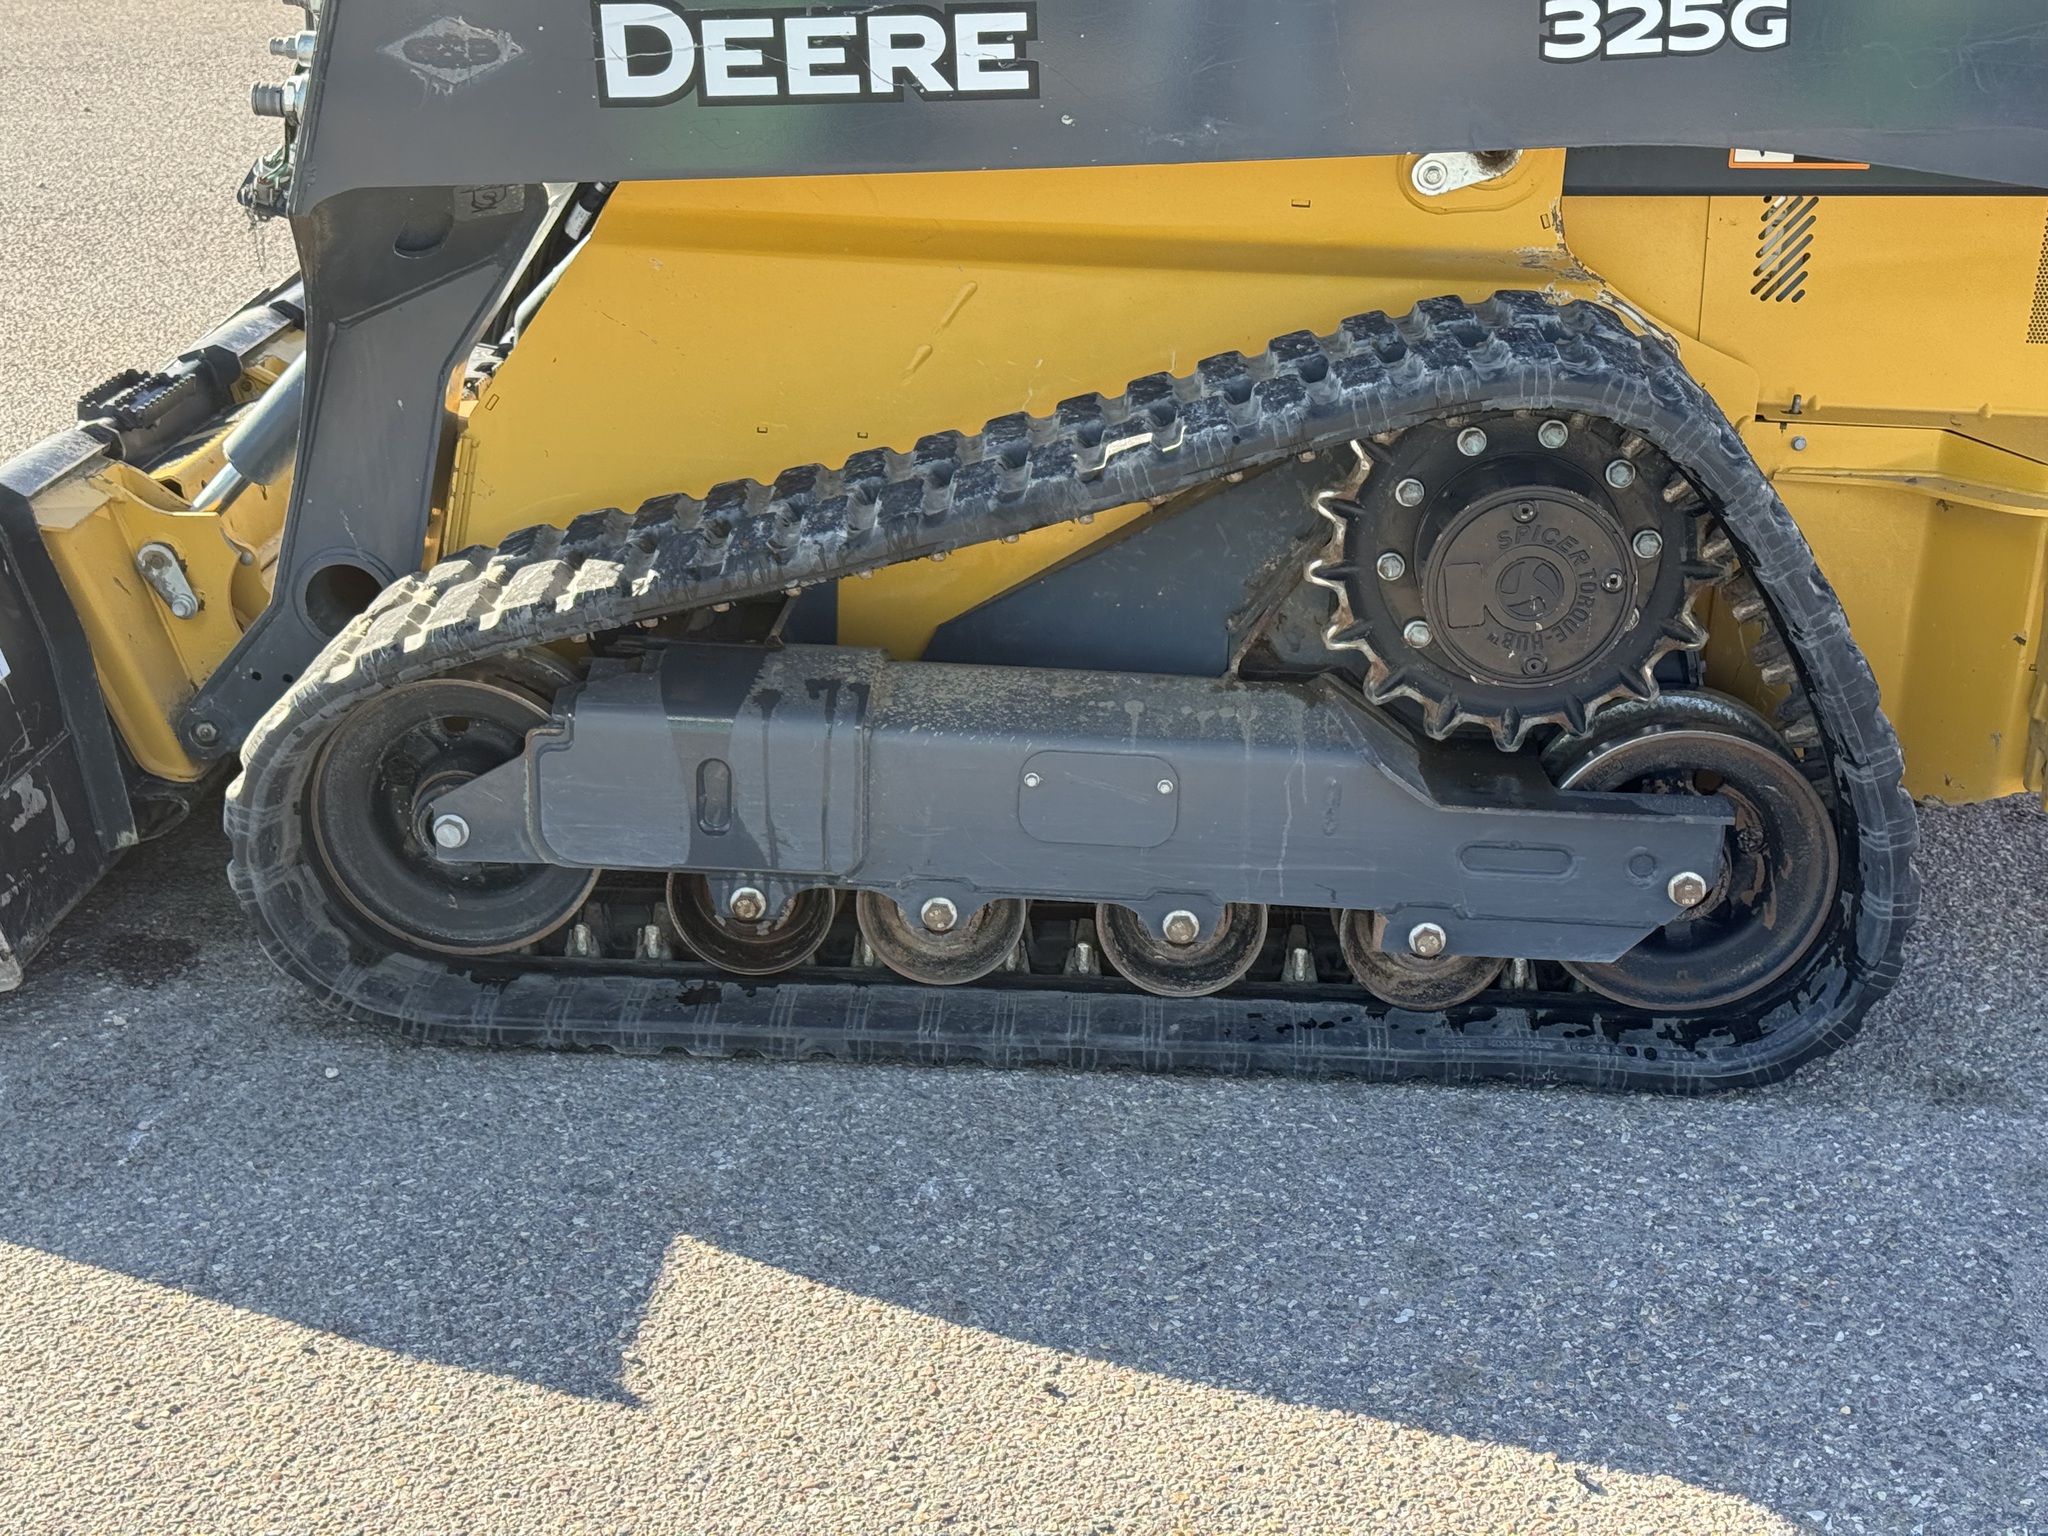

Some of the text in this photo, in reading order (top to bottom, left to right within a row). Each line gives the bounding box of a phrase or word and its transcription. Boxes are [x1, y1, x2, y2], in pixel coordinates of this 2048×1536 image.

[600, 3, 1029, 98] DEERE
[1544, 0, 1788, 59] 325G
[1496, 524, 1591, 567] SPICER
